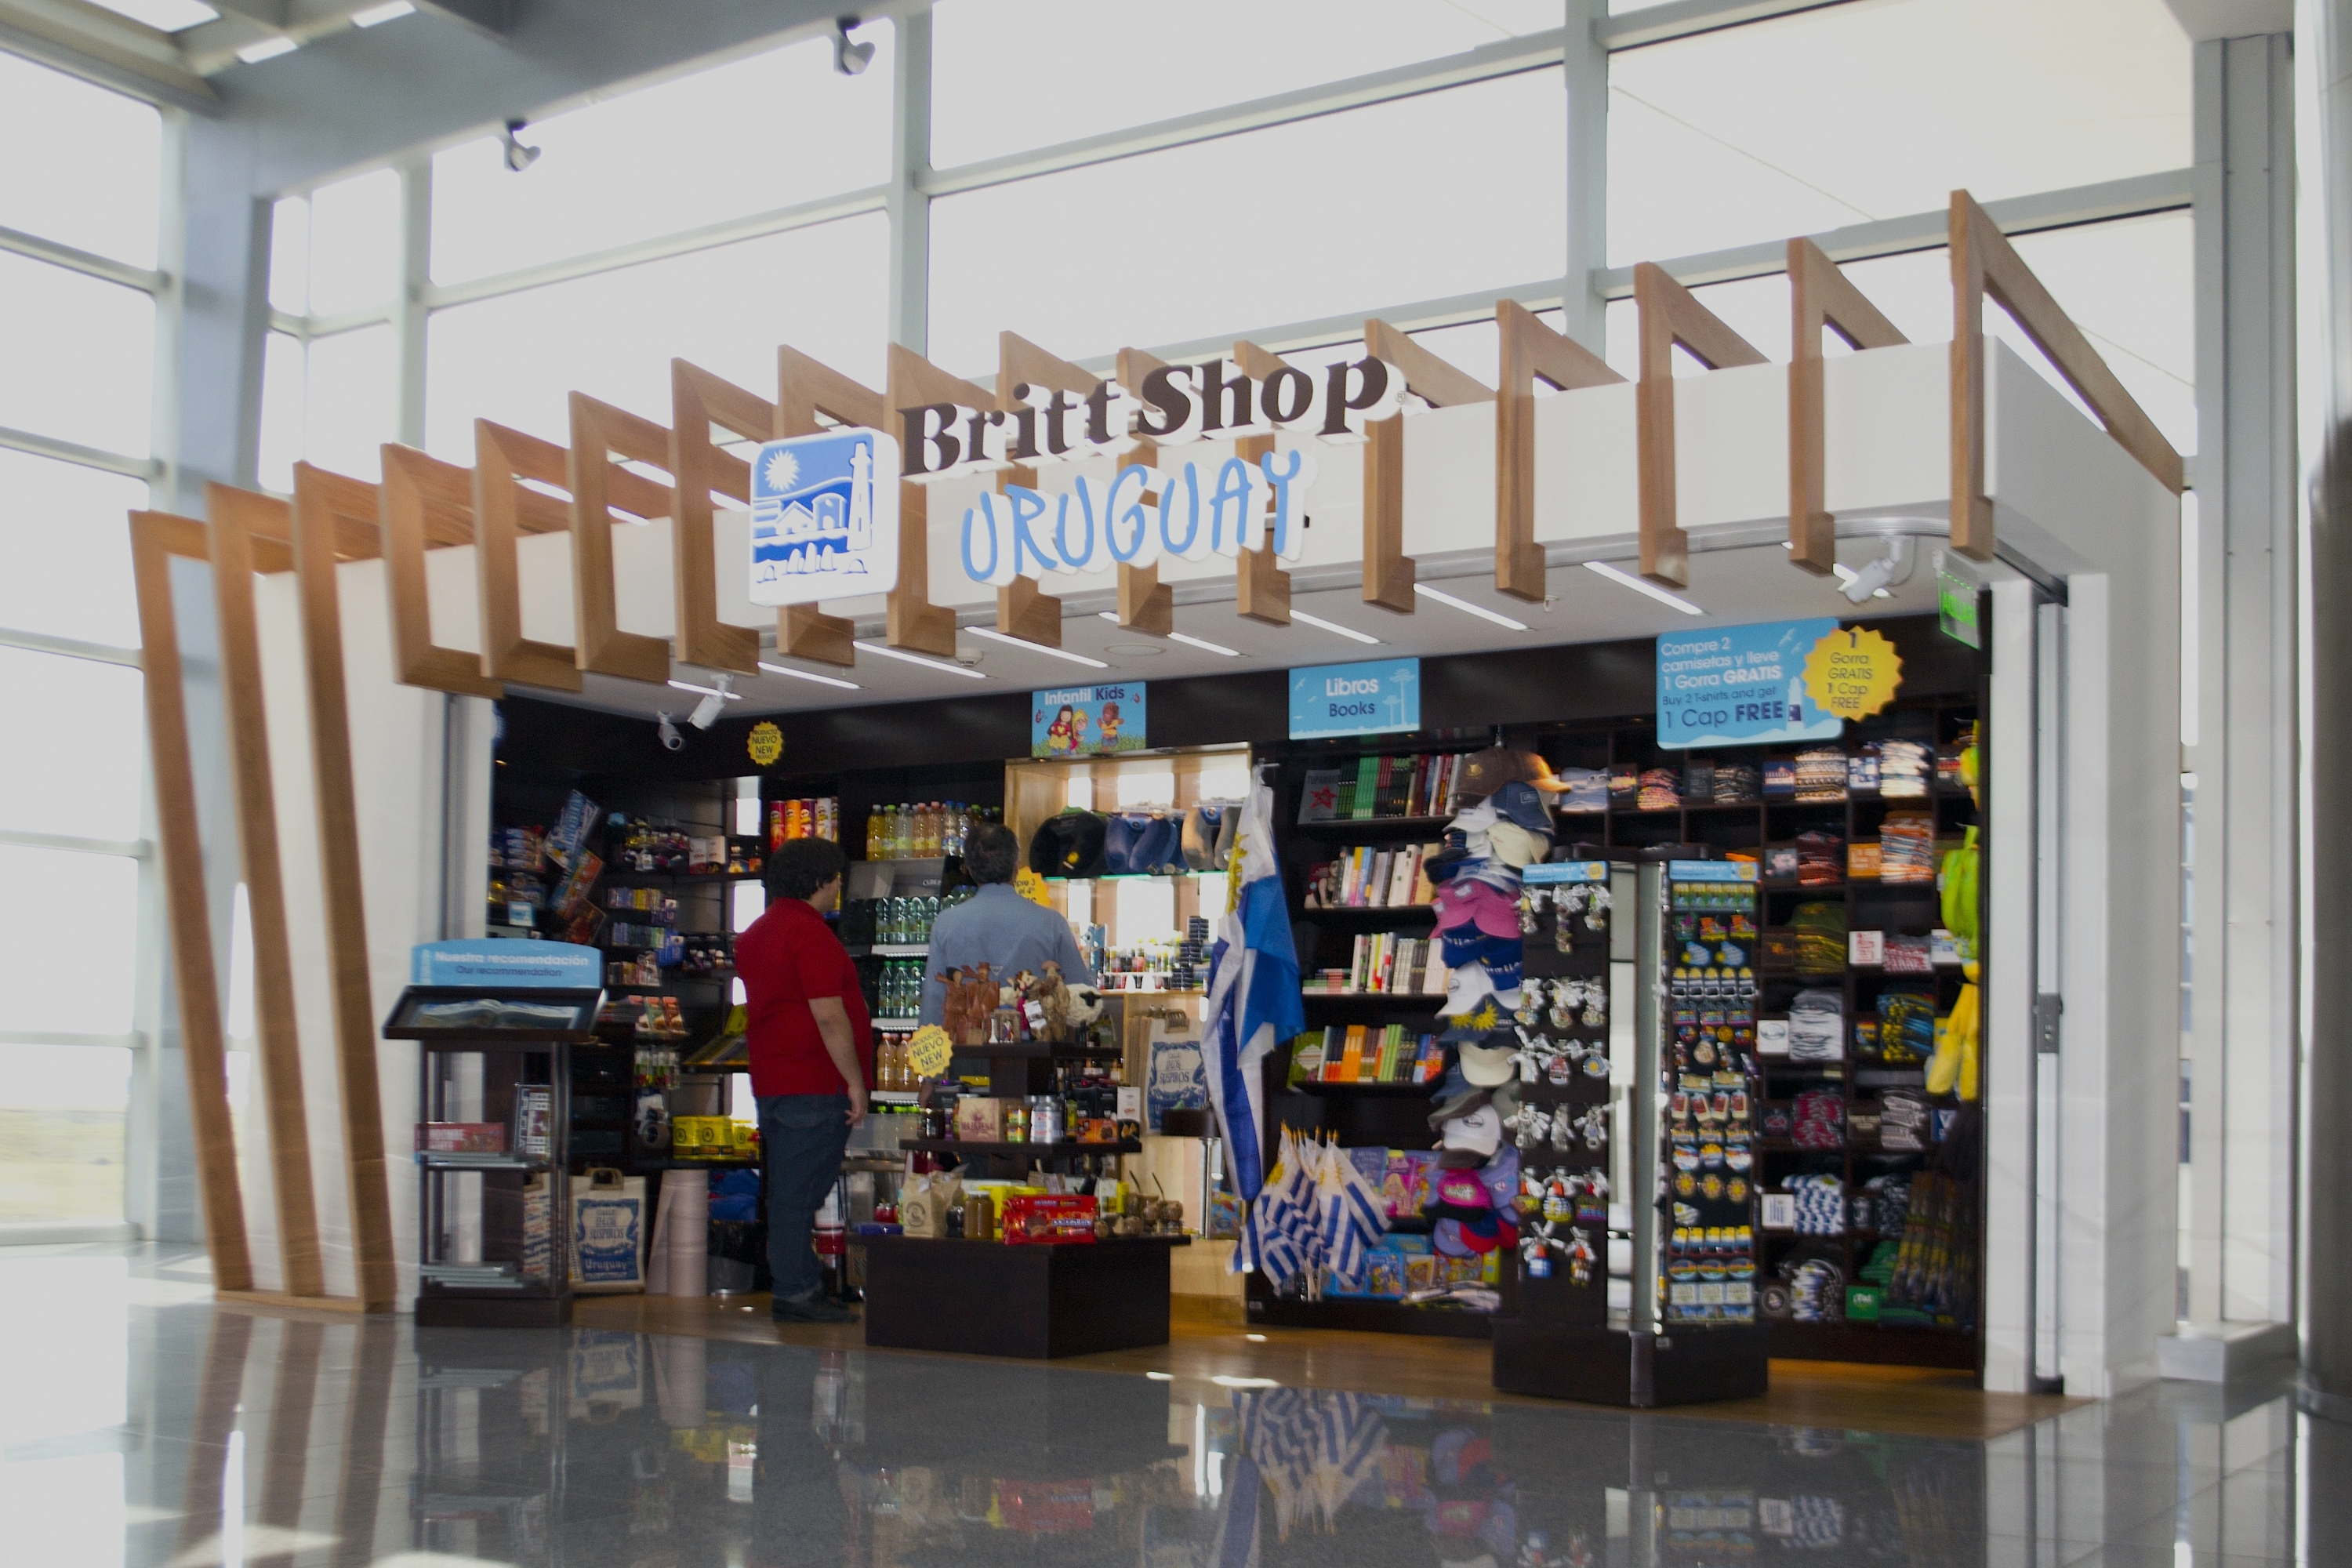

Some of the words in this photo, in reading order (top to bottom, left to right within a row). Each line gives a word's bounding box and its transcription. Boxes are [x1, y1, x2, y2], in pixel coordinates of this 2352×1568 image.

[896, 380, 1121, 477] Britt
[1138, 355, 1388, 436] Shop
[961, 449, 1301, 581] URUGUAY
[1661, 640, 1719, 657] Compre
[1722, 637, 1731, 650] 2
[1849, 631, 1857, 648] 1
[1661, 655, 1733, 673] camisetas
[1734, 655, 1744, 668] y
[1746, 651, 1780, 664] lleve
[1829, 652, 1869, 665] Gorra
[1664, 676, 1671, 690] 1
[1675, 674, 1721, 689] Gorra
[1722, 665, 1783, 684] GRATIS
[1828, 667, 1873, 680] GRATIS
[1044, 688, 1091, 706] Infantil
[1095, 686, 1125, 701] Kids
[1326, 677, 1379, 696] Libros
[1662, 695, 1682, 706] Buy
[1686, 693, 1692, 703] 2
[1694, 691, 1729, 702] T-shirts
[1731, 687, 1755, 699] and
[1757, 686, 1777, 699] get
[1827, 682, 1833, 694] 1
[1837, 681, 1868, 695] Cap
[1329, 700, 1376, 717] Books
[1831, 696, 1860, 709] FREE
[1665, 710, 1672, 728] 1
[1681, 708, 1728, 728] Cap
[1734, 700, 1784, 722] FREE
[751, 735, 777, 744] NUEVO
[755, 745, 774, 753] NEW
[434, 951, 485, 964] Nuestra
[487, 953, 590, 966] recomendación
[456, 965, 475, 975] Our
[477, 967, 562, 977] recommendation
[912, 1036, 944, 1059] NUEVO
[920, 1048, 943, 1067] NEW
